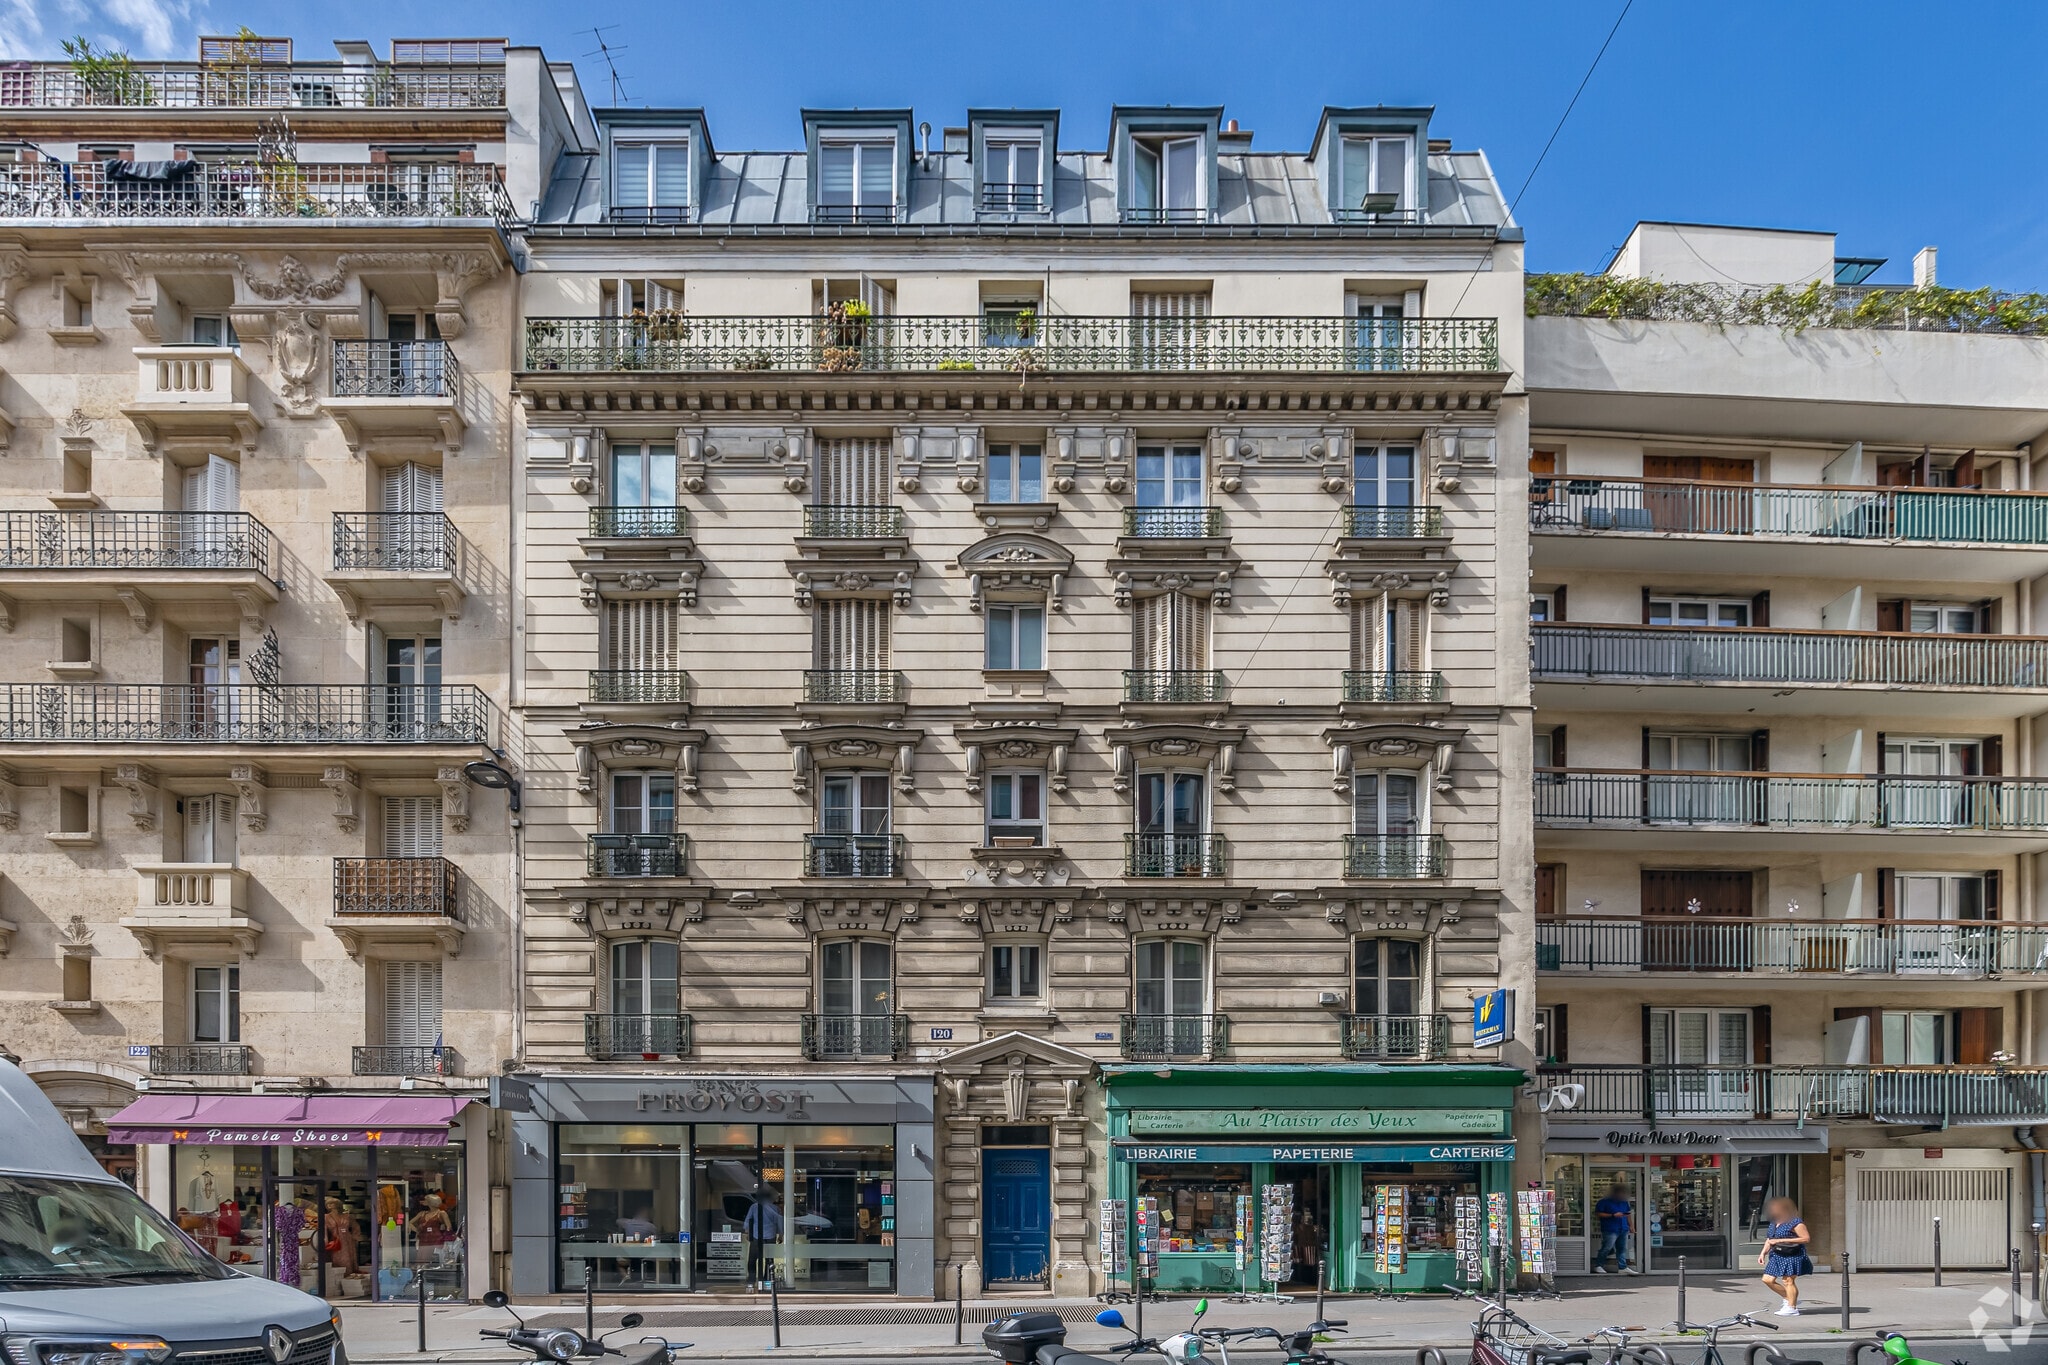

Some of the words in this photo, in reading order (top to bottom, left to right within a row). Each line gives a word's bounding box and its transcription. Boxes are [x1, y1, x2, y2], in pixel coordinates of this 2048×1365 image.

[933, 1029, 950, 1039] 120
[130, 1046, 148, 1056] 122
[636, 1088, 814, 1113] PROVOST
[1218, 1113, 1252, 1128] Au
[1258, 1113, 1323, 1128] Plaisir
[1330, 1113, 1360, 1127] des
[1367, 1112, 1418, 1130] Yeux
[206, 1128, 281, 1142] Pamela
[292, 1128, 349, 1142] Shoes
[1606, 1130, 1647, 1148] Optic
[1648, 1130, 1682, 1145] Next
[1683, 1130, 1722, 1145] Door
[1126, 1148, 1197, 1159] LIBRAIRIE
[1272, 1148, 1354, 1159] PAPETERIE
[1429, 1147, 1505, 1158] CARTERIE
